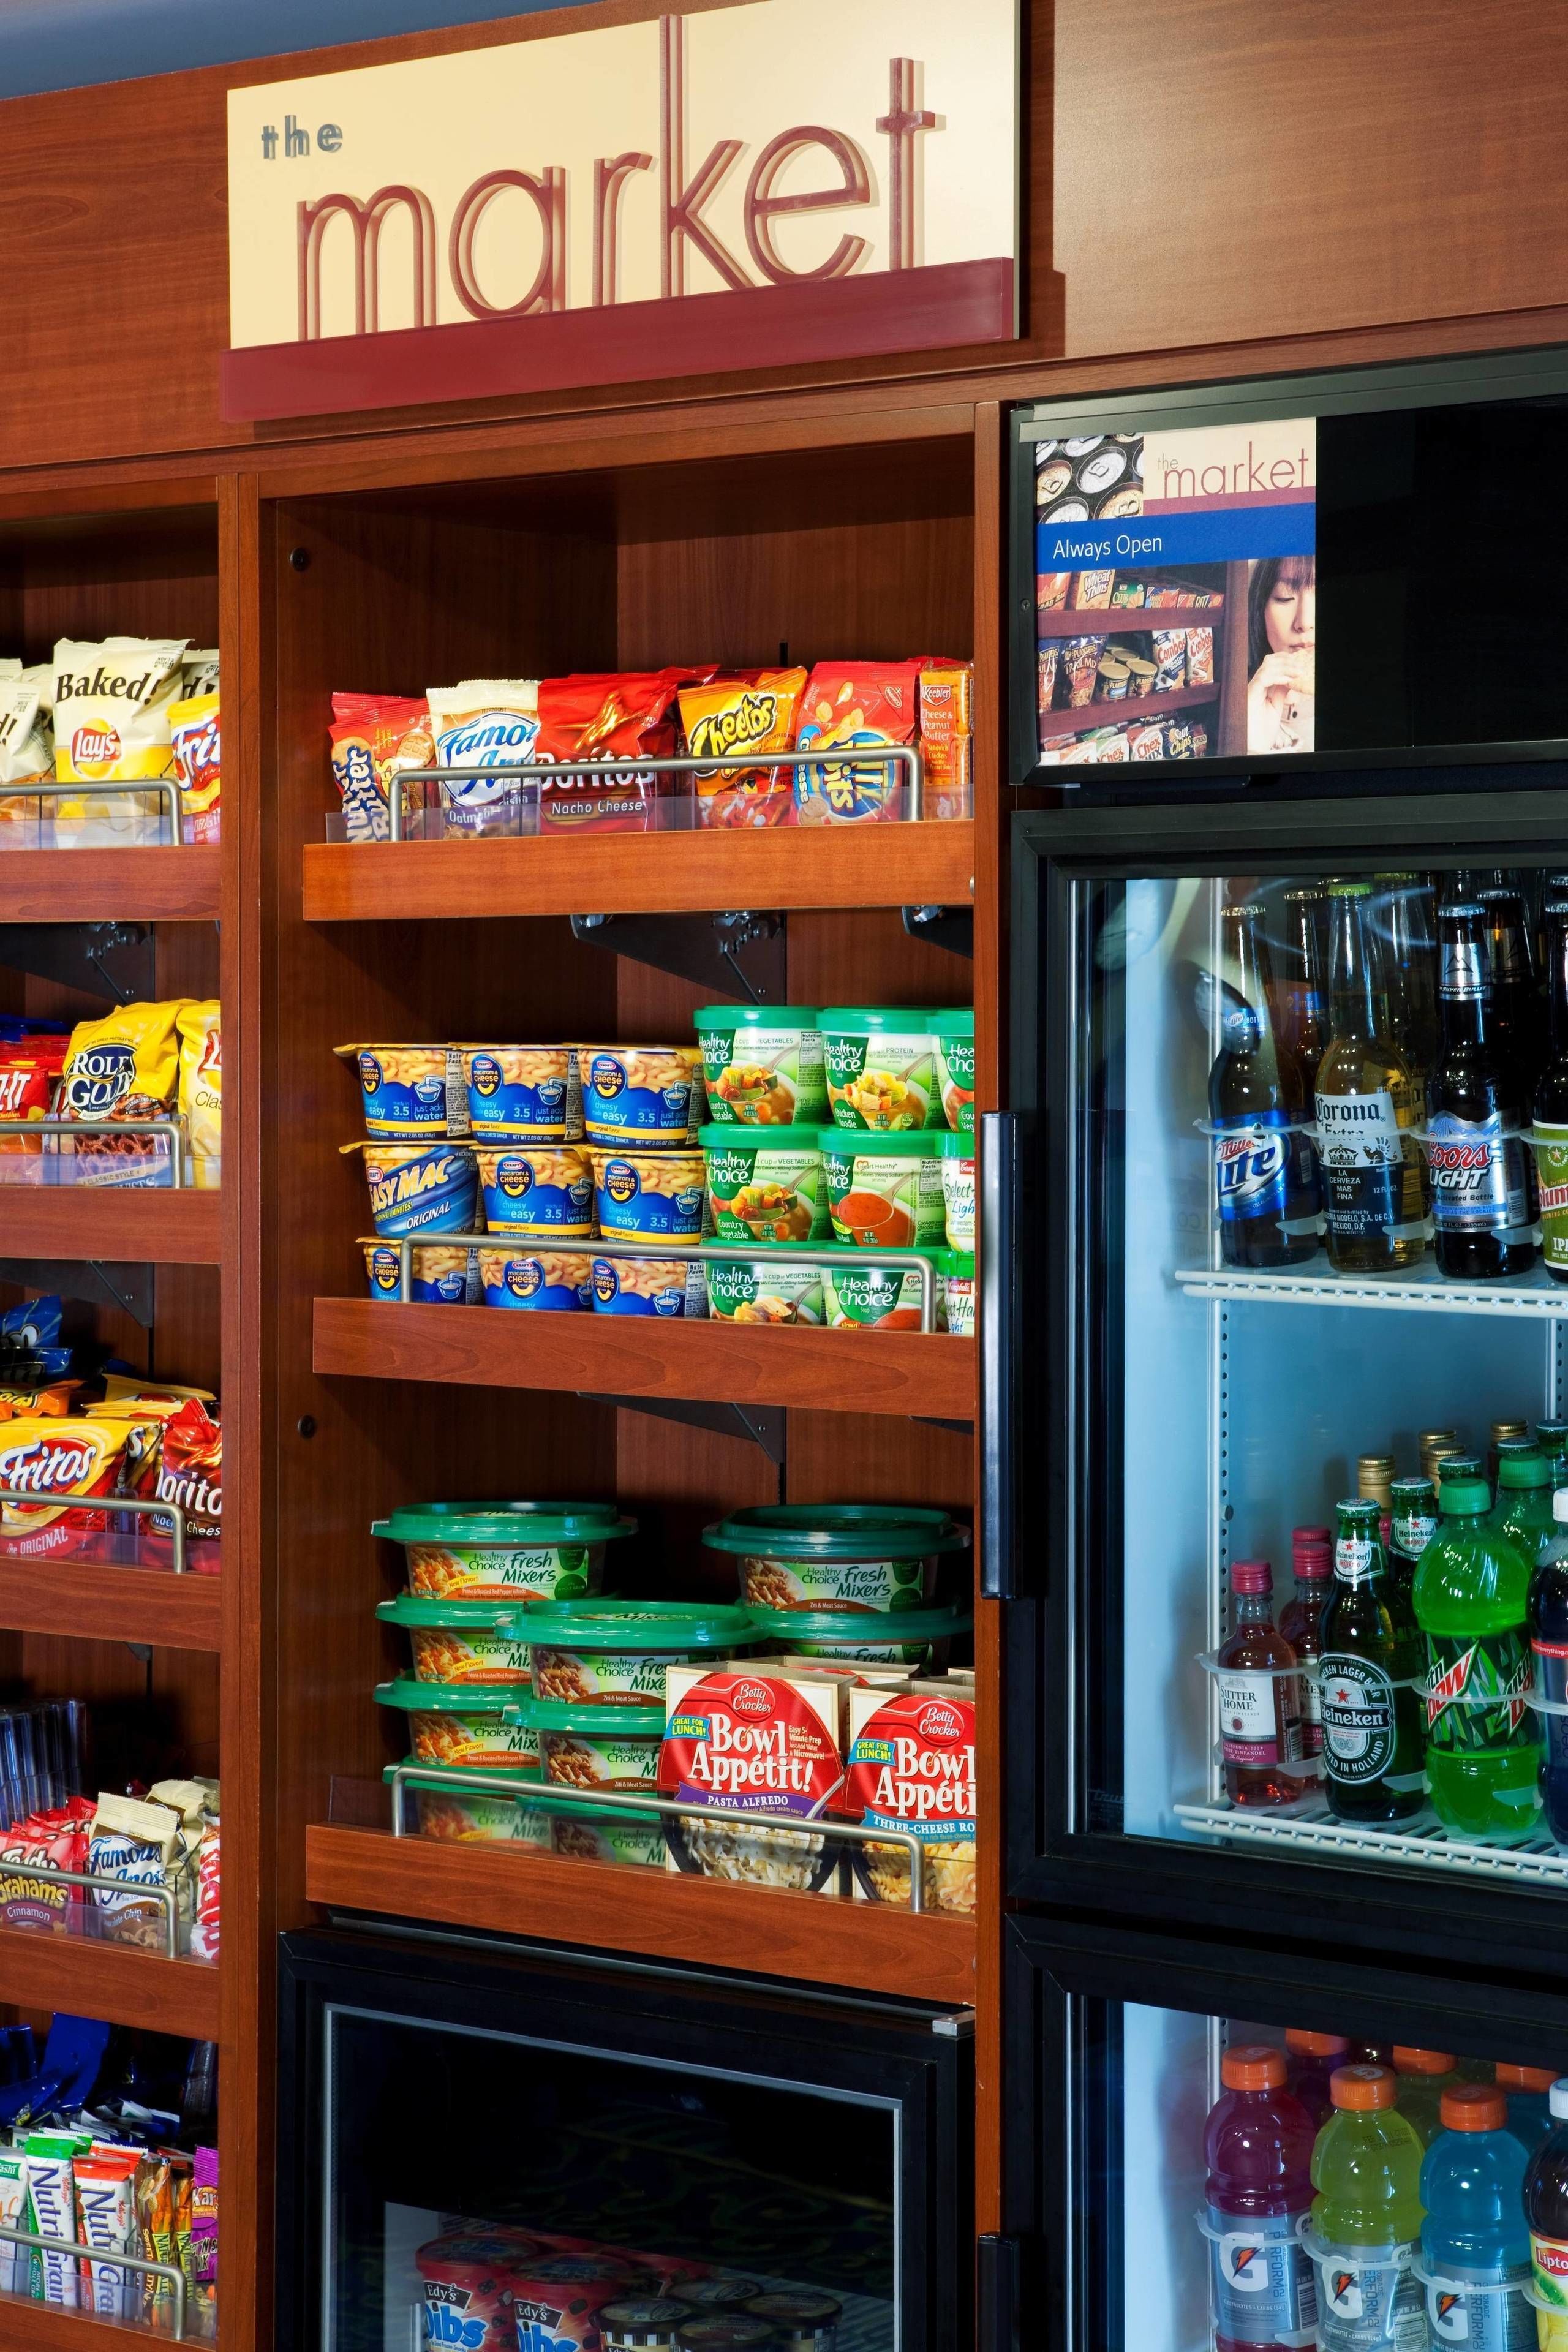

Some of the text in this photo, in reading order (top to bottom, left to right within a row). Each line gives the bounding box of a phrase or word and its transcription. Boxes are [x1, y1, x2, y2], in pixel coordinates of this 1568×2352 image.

[260, 113, 343, 159] the
[296, 13, 943, 342] market
[1158, 452, 1178, 471] the
[1164, 440, 1309, 499] market
[1053, 533, 1162, 562] Always Open
[1156, 638, 1187, 663] Combos
[55, 666, 162, 705] Baked!
[923, 686, 949, 703] Keebler
[921, 709, 947, 719] Cheese
[924, 720, 951, 730] Peanut
[691, 695, 777, 775] Cheetos
[925, 731, 951, 741] Butter
[74, 729, 118, 763] Lay's
[552, 800, 643, 815] Nacho Cheese
[699, 1032, 731, 1052] Healthy
[824, 1038, 863, 1060] Healthy
[369, 1106, 445, 1121] easy 3.5 water
[413, 1103, 445, 1115] just add
[484, 1107, 564, 1123] easy 3.5 water
[535, 1105, 564, 1116] just add
[660, 1111, 674, 1121] just
[835, 1109, 856, 1119] Chicken
[1315, 1096, 1381, 1122] Corona
[602, 1111, 687, 1128] easy 3.5 water
[1428, 1133, 1492, 1169] Coors
[709, 1151, 752, 1172] Healthy
[1216, 1146, 1276, 1194] Lite
[87, 1170, 135, 1186] CLASSIC STYLE
[397, 1154, 456, 1202] MAC
[709, 1166, 748, 1183] Choice
[1329, 1176, 1361, 1185] CERVEZA
[1430, 1168, 1488, 1189] LIGHT
[369, 1176, 398, 1214] EASY
[502, 1200, 527, 1211] cheesy
[406, 1201, 451, 1230] ORIGINAL
[511, 1209, 536, 1223] easy
[545, 1208, 562, 1219] 3.5
[616, 1215, 641, 1230] easy
[650, 1216, 668, 1227] 3.5
[718, 1219, 744, 1230] Country
[711, 1266, 756, 1286] Healthy
[710, 1281, 752, 1298] Choice
[842, 1276, 899, 1295] Healthy
[838, 1289, 894, 1306] Choice
[1, 1440, 96, 1498] Fritos
[20, 1526, 68, 1555] ORIGINAL
[474, 1551, 552, 1569] Healthy Fresh
[469, 1561, 556, 1585] Choice Mixers
[806, 1565, 888, 1583] Healthy Fresh
[801, 1574, 891, 1599] Choice Mixers
[474, 1644, 511, 1654] Choice
[596, 1666, 634, 1676] Choice
[601, 1657, 636, 1668] Healthy
[1338, 1665, 1366, 1680] LAGER
[740, 1683, 767, 1701] Betty
[1220, 1685, 1257, 1702] SUTTER
[733, 1694, 771, 1713] Crocker
[1223, 1698, 1253, 1711] HOME
[673, 1717, 704, 1727] GREAT FOR
[926, 1706, 955, 1727] Betty
[1321, 1705, 1384, 1726] Heineken
[672, 1725, 706, 1737] LUNCH!
[707, 1713, 788, 1757] Bowl
[788, 1725, 801, 1735] Easy
[919, 1719, 959, 1737] Crocker
[788, 1734, 822, 1746] Minute Prep
[858, 1741, 888, 1751] GREAT FOR
[793, 1751, 825, 1760] Microwave!
[856, 1749, 891, 1762] LUNCH!
[893, 1737, 976, 1783] Bowl
[1340, 1741, 1384, 1773] IN HOLLAND
[687, 1741, 813, 1793] Appétit!
[707, 1795, 788, 1807] PASTA ALFREDO
[873, 1815, 956, 1834] THREE-CHEESE
[90, 1838, 162, 1874] Famous
[7, 1906, 50, 1921] Cinnamon
[426, 2283, 457, 2301] Edy's
[518, 2302, 549, 2321] Edy's
